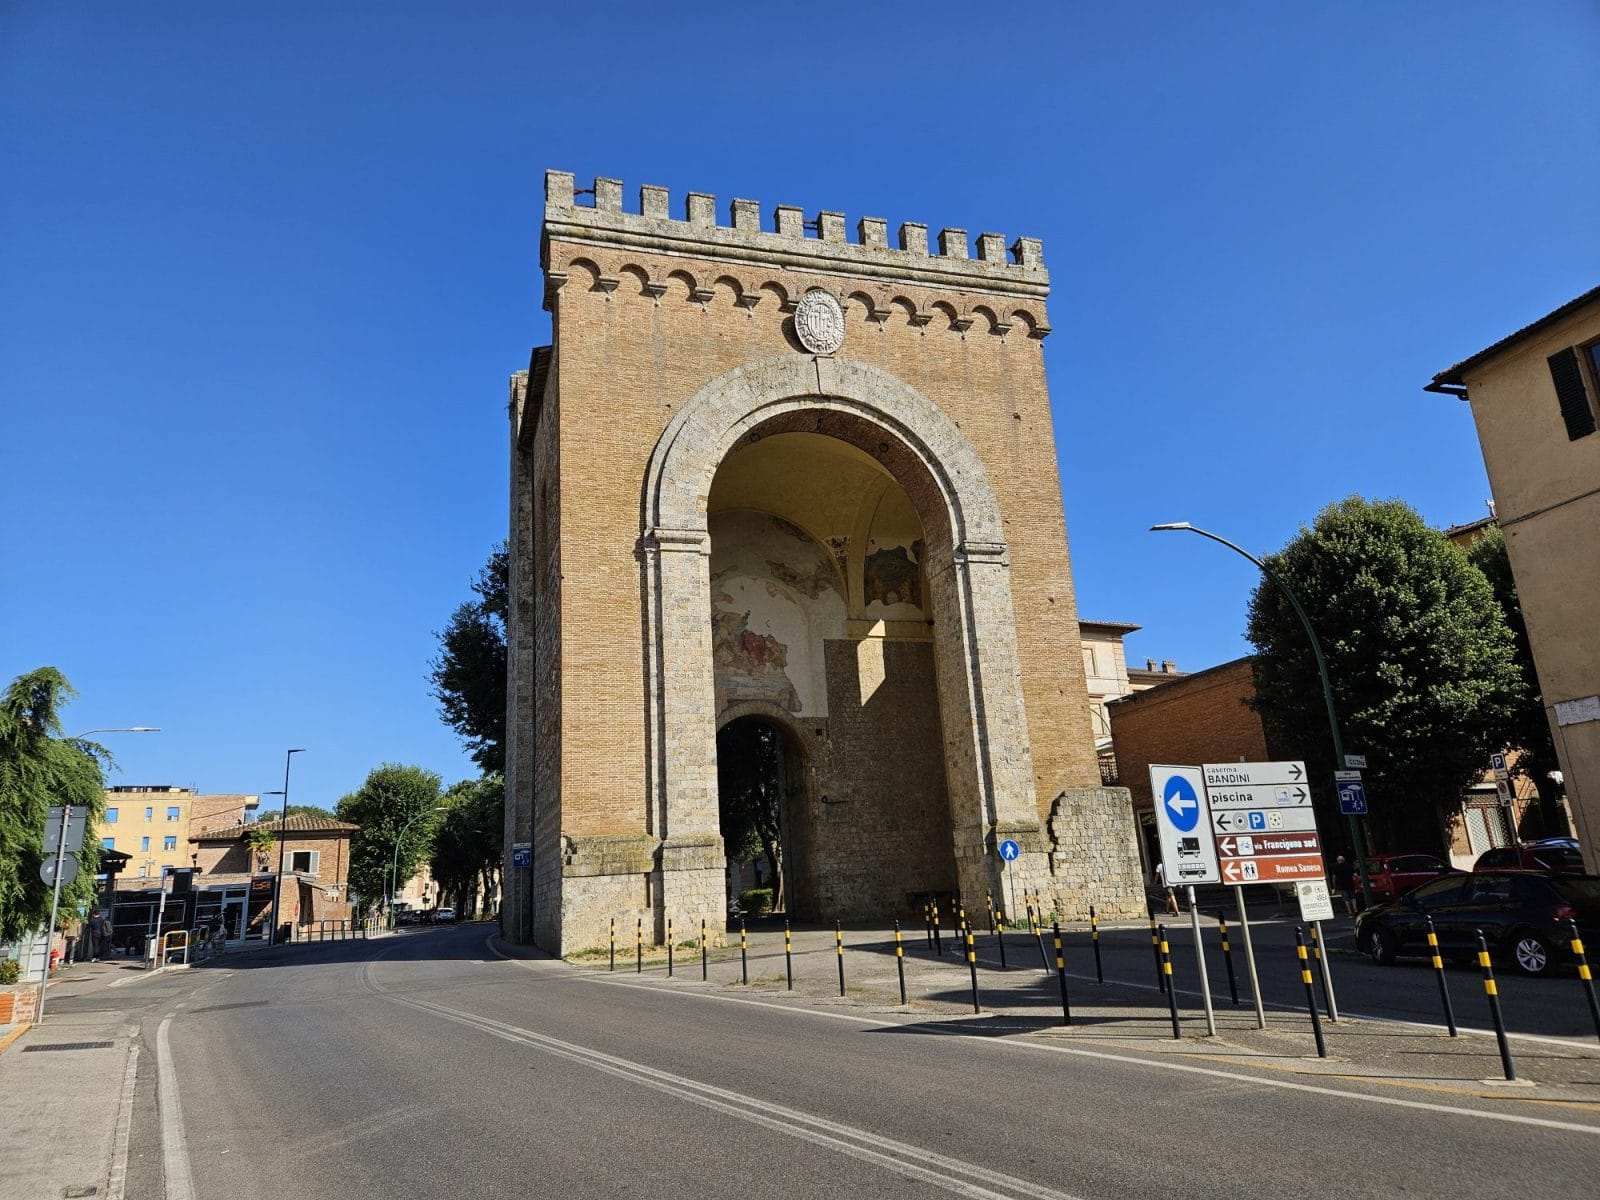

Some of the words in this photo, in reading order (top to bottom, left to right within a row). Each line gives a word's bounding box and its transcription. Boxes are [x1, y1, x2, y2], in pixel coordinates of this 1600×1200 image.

[1494, 757, 1502, 768] P
[1208, 774, 1250, 784] BANDINI
[1211, 791, 1253, 804] piscina
[1252, 813, 1261, 828] P
[1303, 838, 1317, 848] sud
[1275, 864, 1298, 873] Romea
